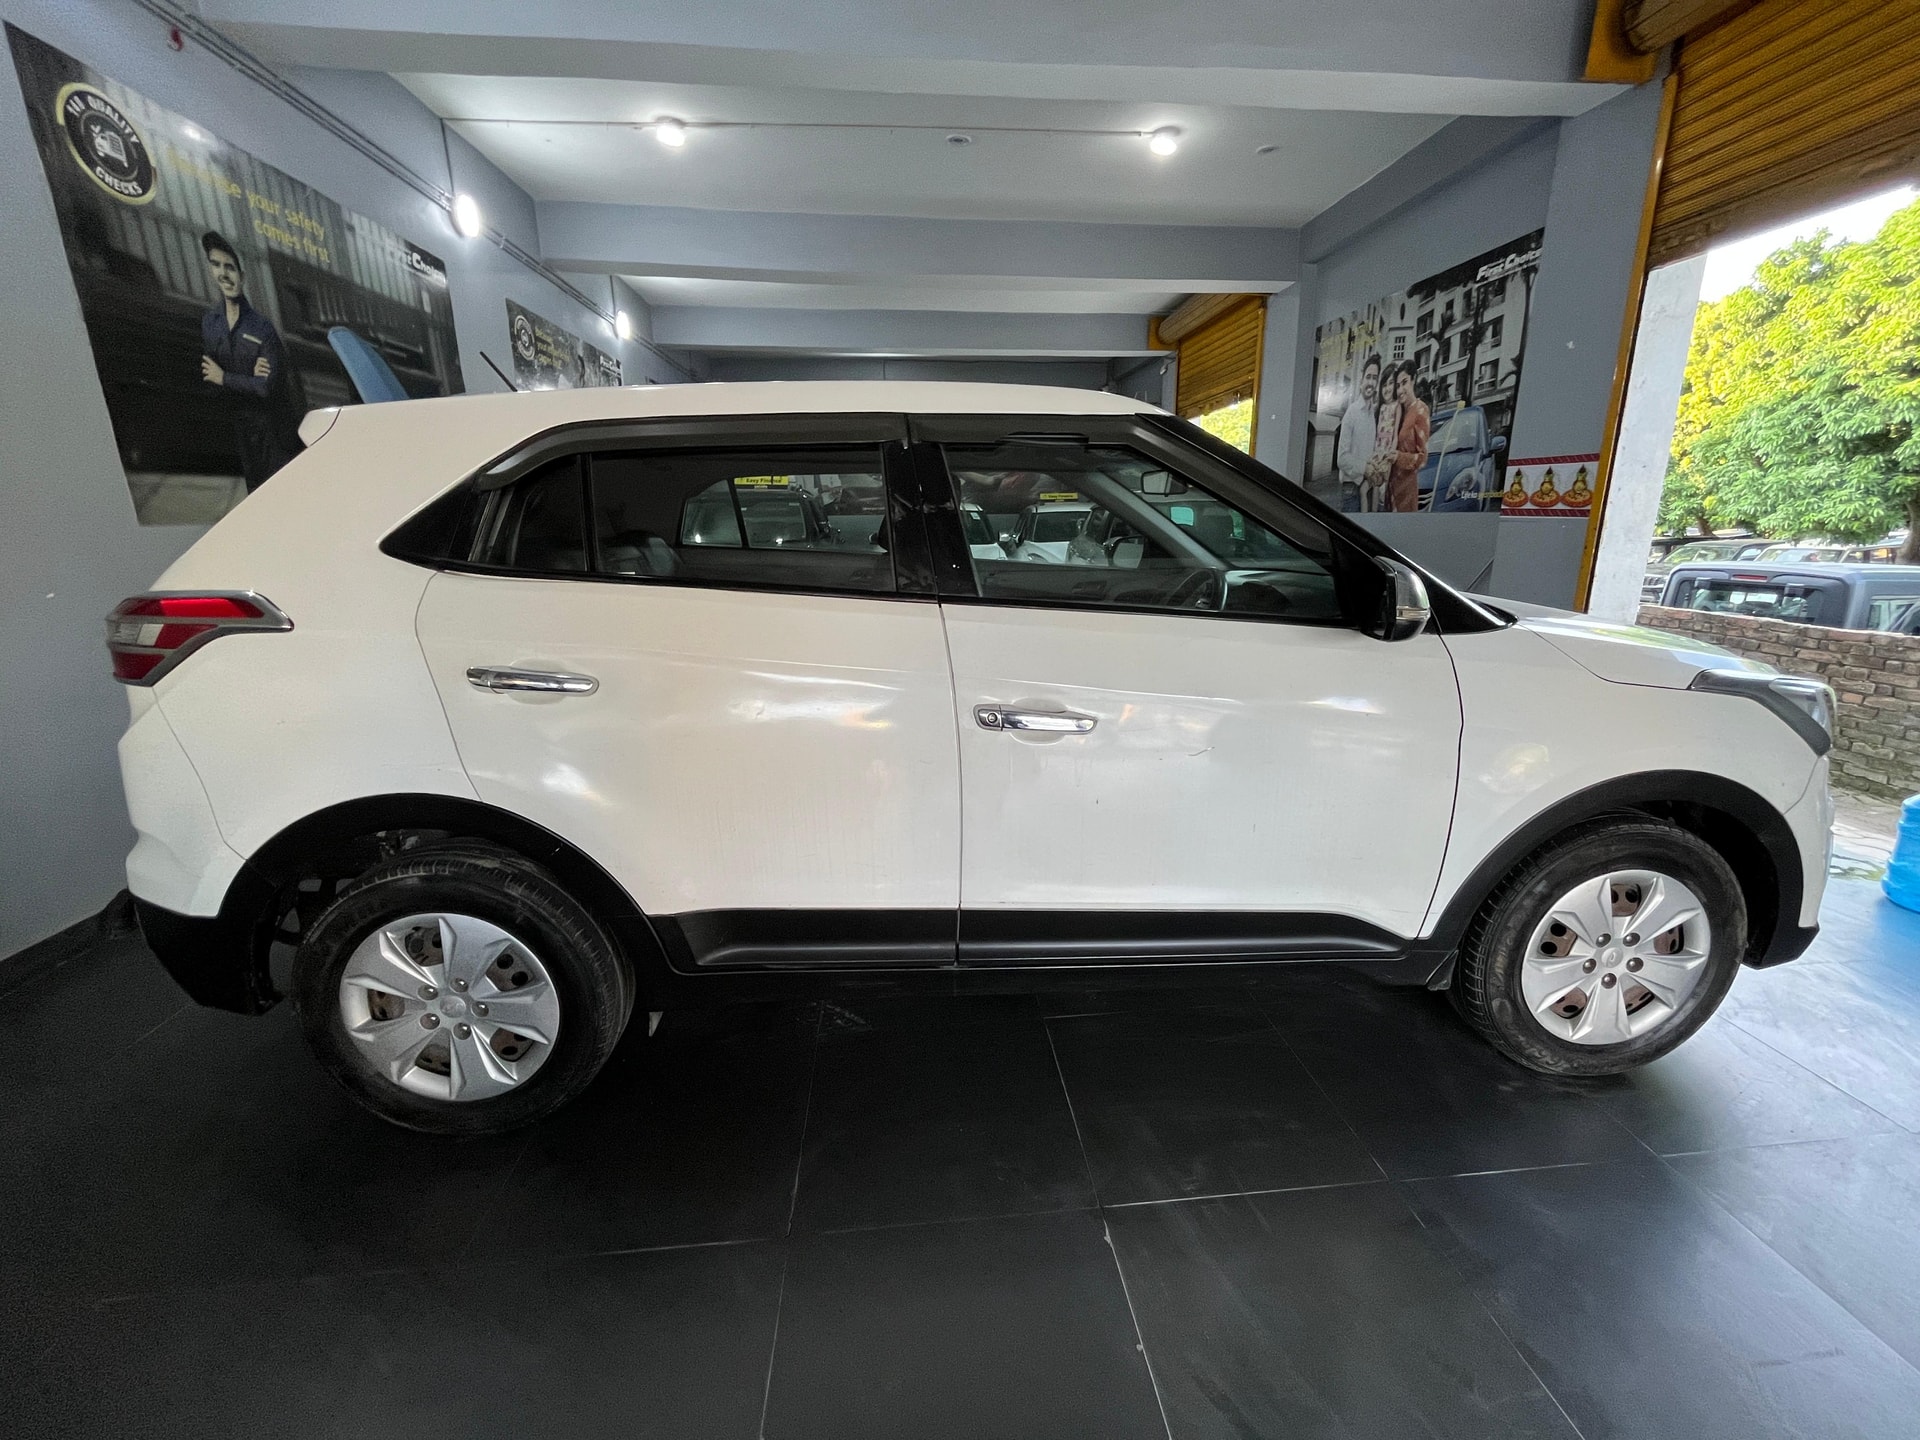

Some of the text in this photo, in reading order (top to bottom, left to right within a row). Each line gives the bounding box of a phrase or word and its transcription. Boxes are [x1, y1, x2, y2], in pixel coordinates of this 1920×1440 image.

[87, 95, 140, 143] QUALITY
[95, 166, 142, 195] CHECKS
[247, 190, 325, 241] your safety
[253, 219, 331, 263] comes first
[1476, 265, 1505, 281] First
